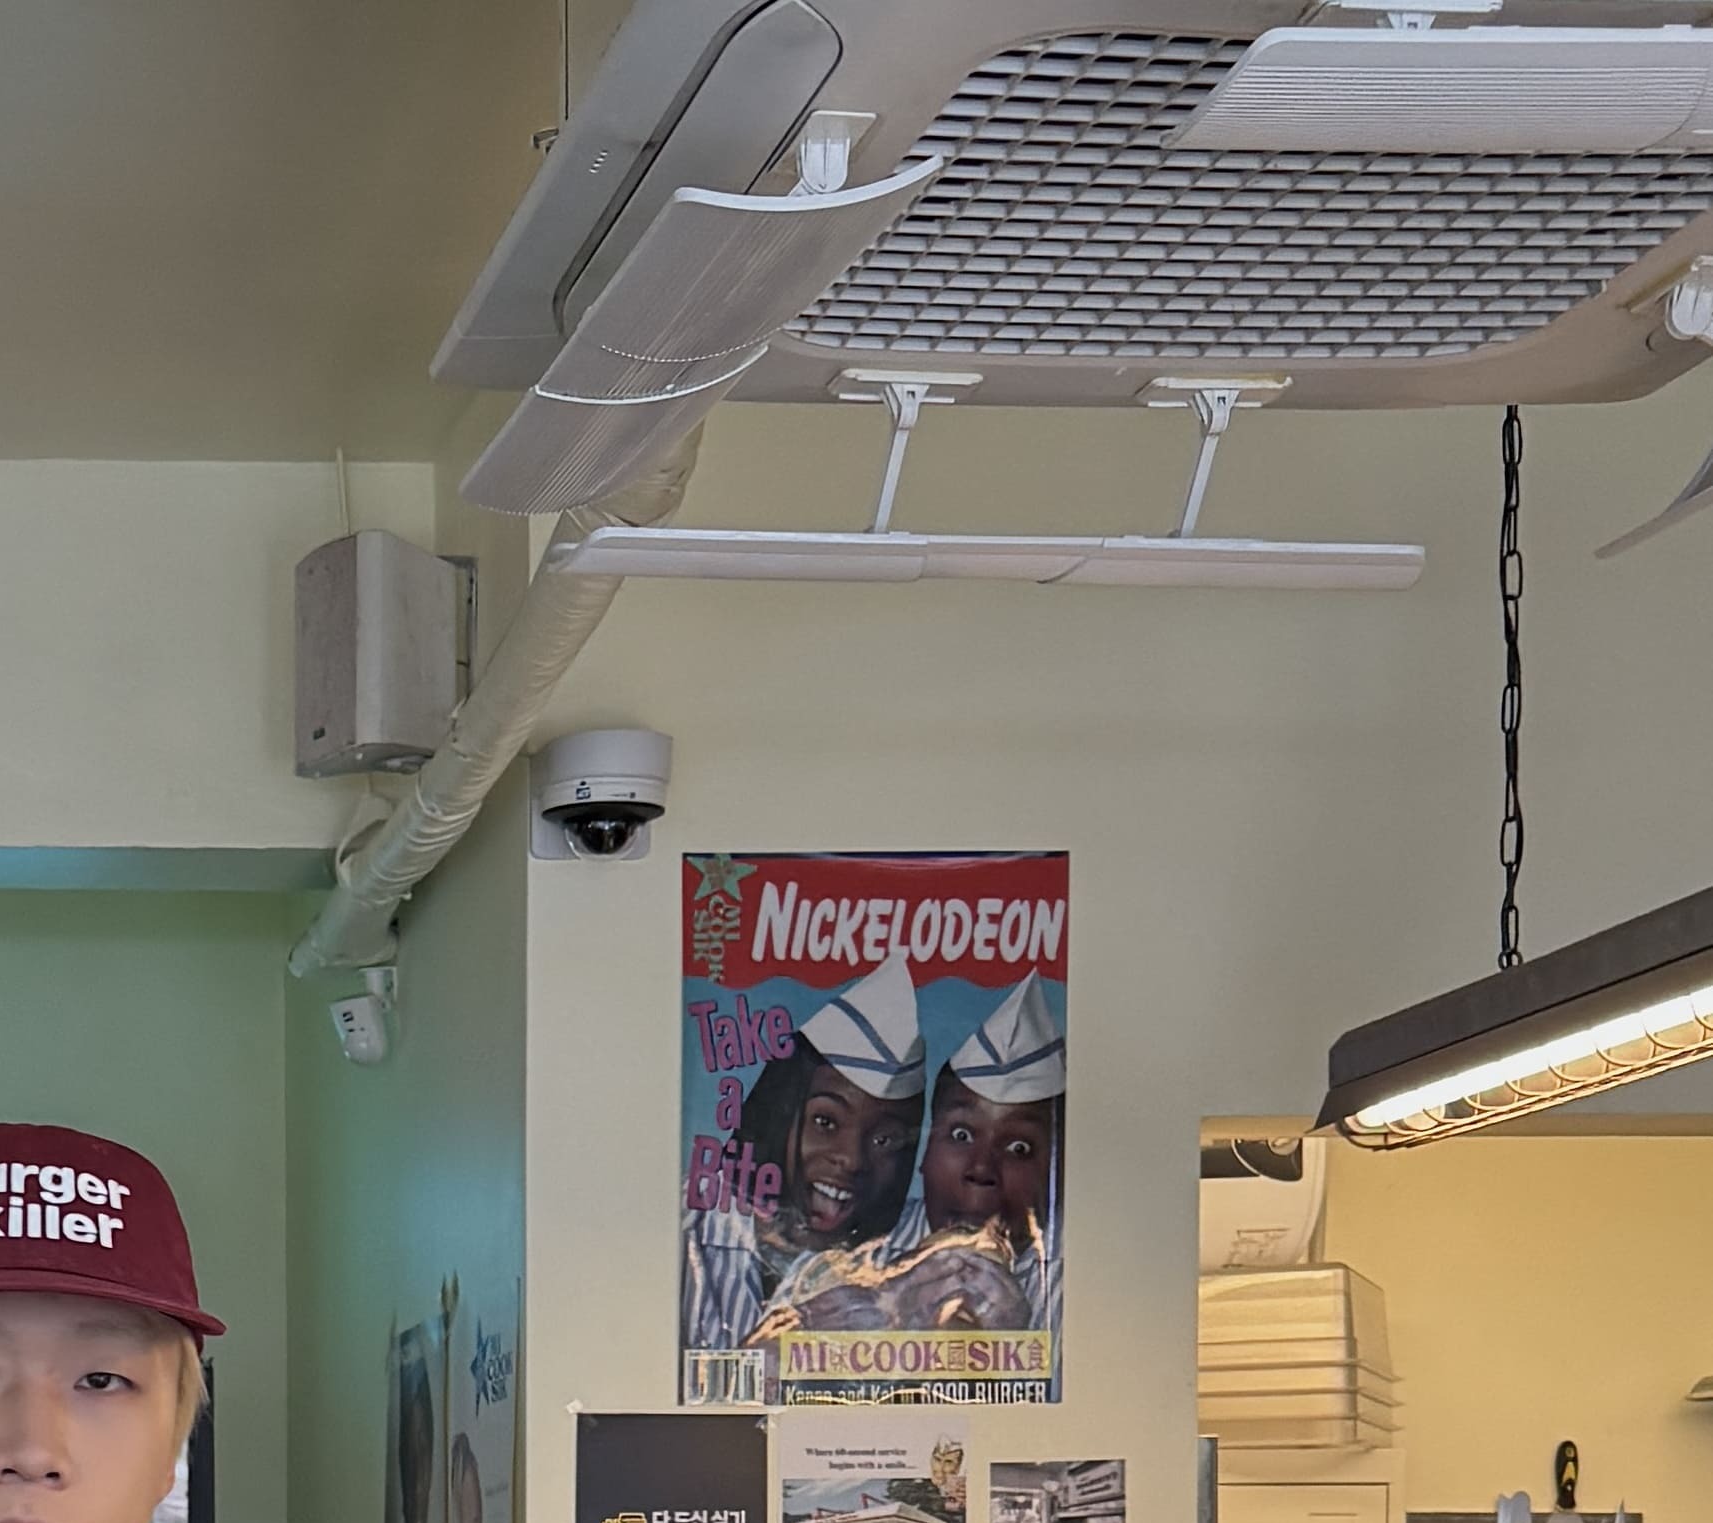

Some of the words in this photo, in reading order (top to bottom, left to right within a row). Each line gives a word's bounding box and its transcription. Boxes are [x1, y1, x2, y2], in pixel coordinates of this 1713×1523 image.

[751, 880, 1065, 966] NICKELODEON
[688, 994, 795, 1073] Take
[716, 1076, 742, 1131] a
[686, 1135, 782, 1219] Bite
[975, 1381, 1046, 1405] BURGER
